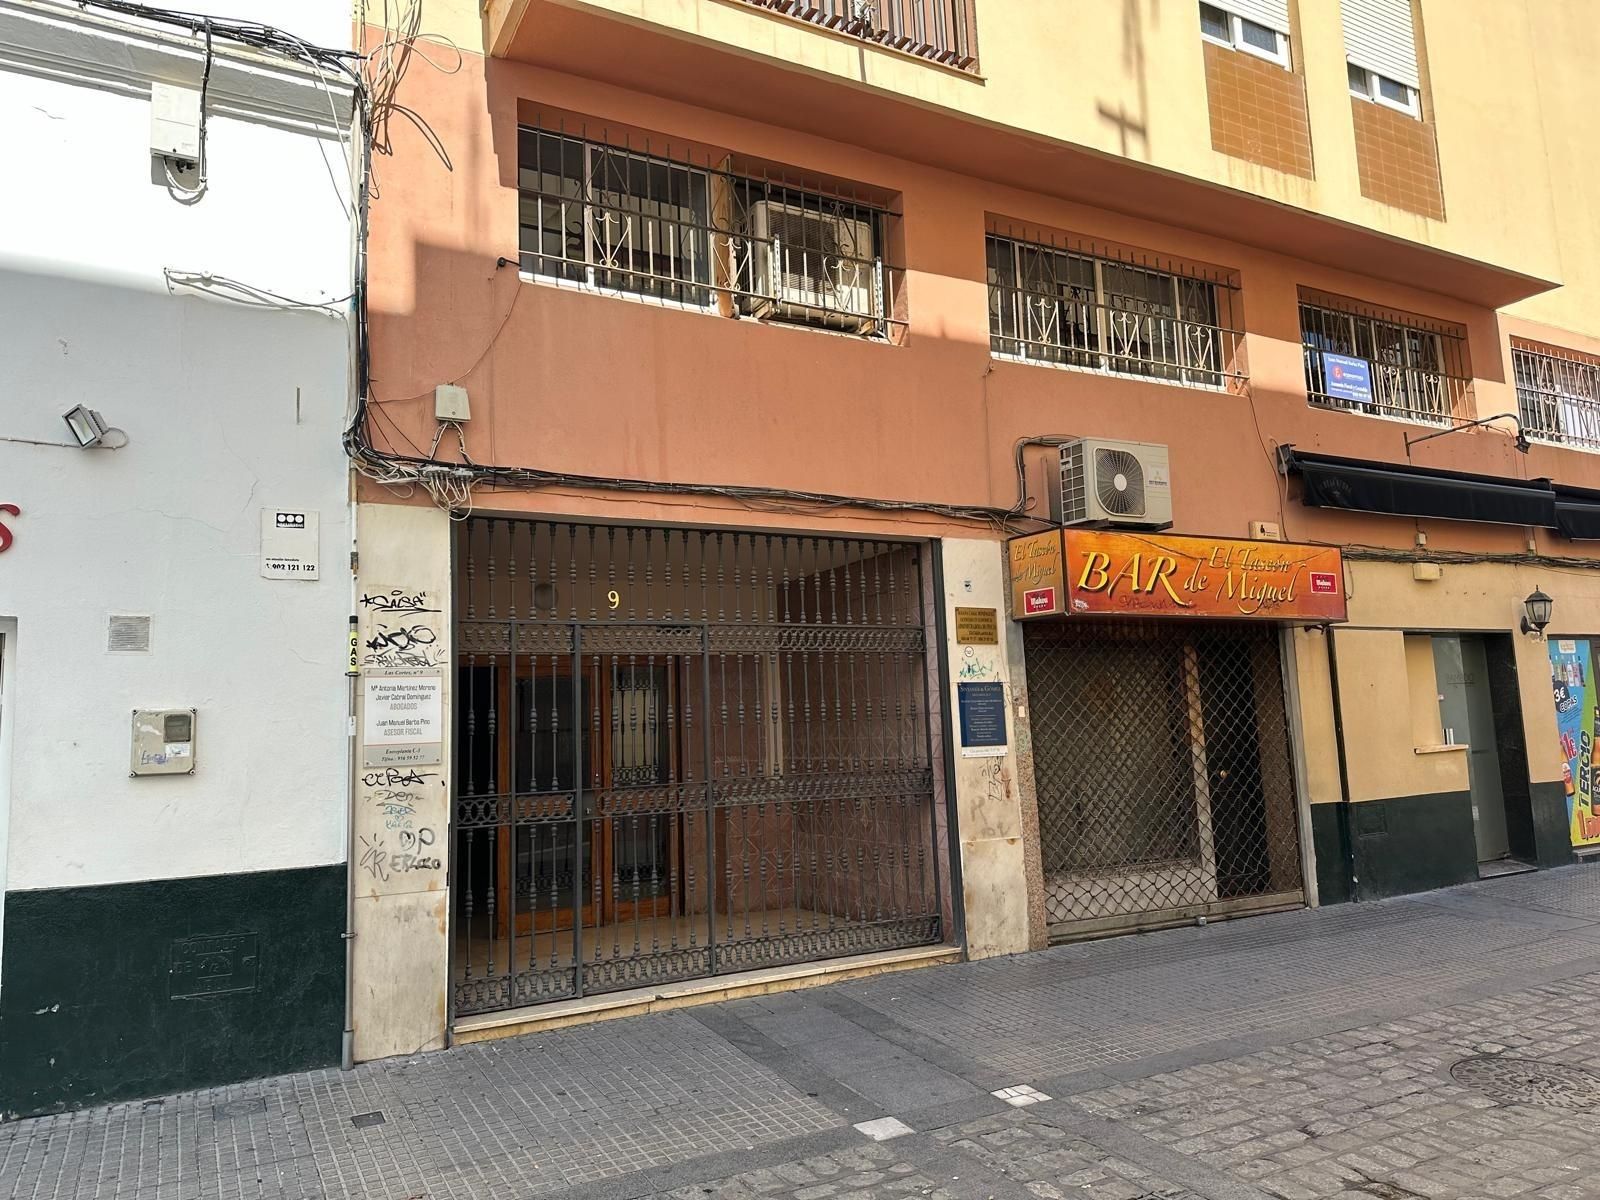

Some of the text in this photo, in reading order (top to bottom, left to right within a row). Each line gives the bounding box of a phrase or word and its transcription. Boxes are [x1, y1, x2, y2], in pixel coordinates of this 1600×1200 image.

[1208, 546, 1233, 569] El
[1077, 551, 1307, 614] BAR de Miguel
[607, 590, 620, 609] 9
[350, 637, 358, 667] GAS
[383, 727, 423, 736] ASESOR FISCAL
[1579, 730, 1592, 807] TERCIO
